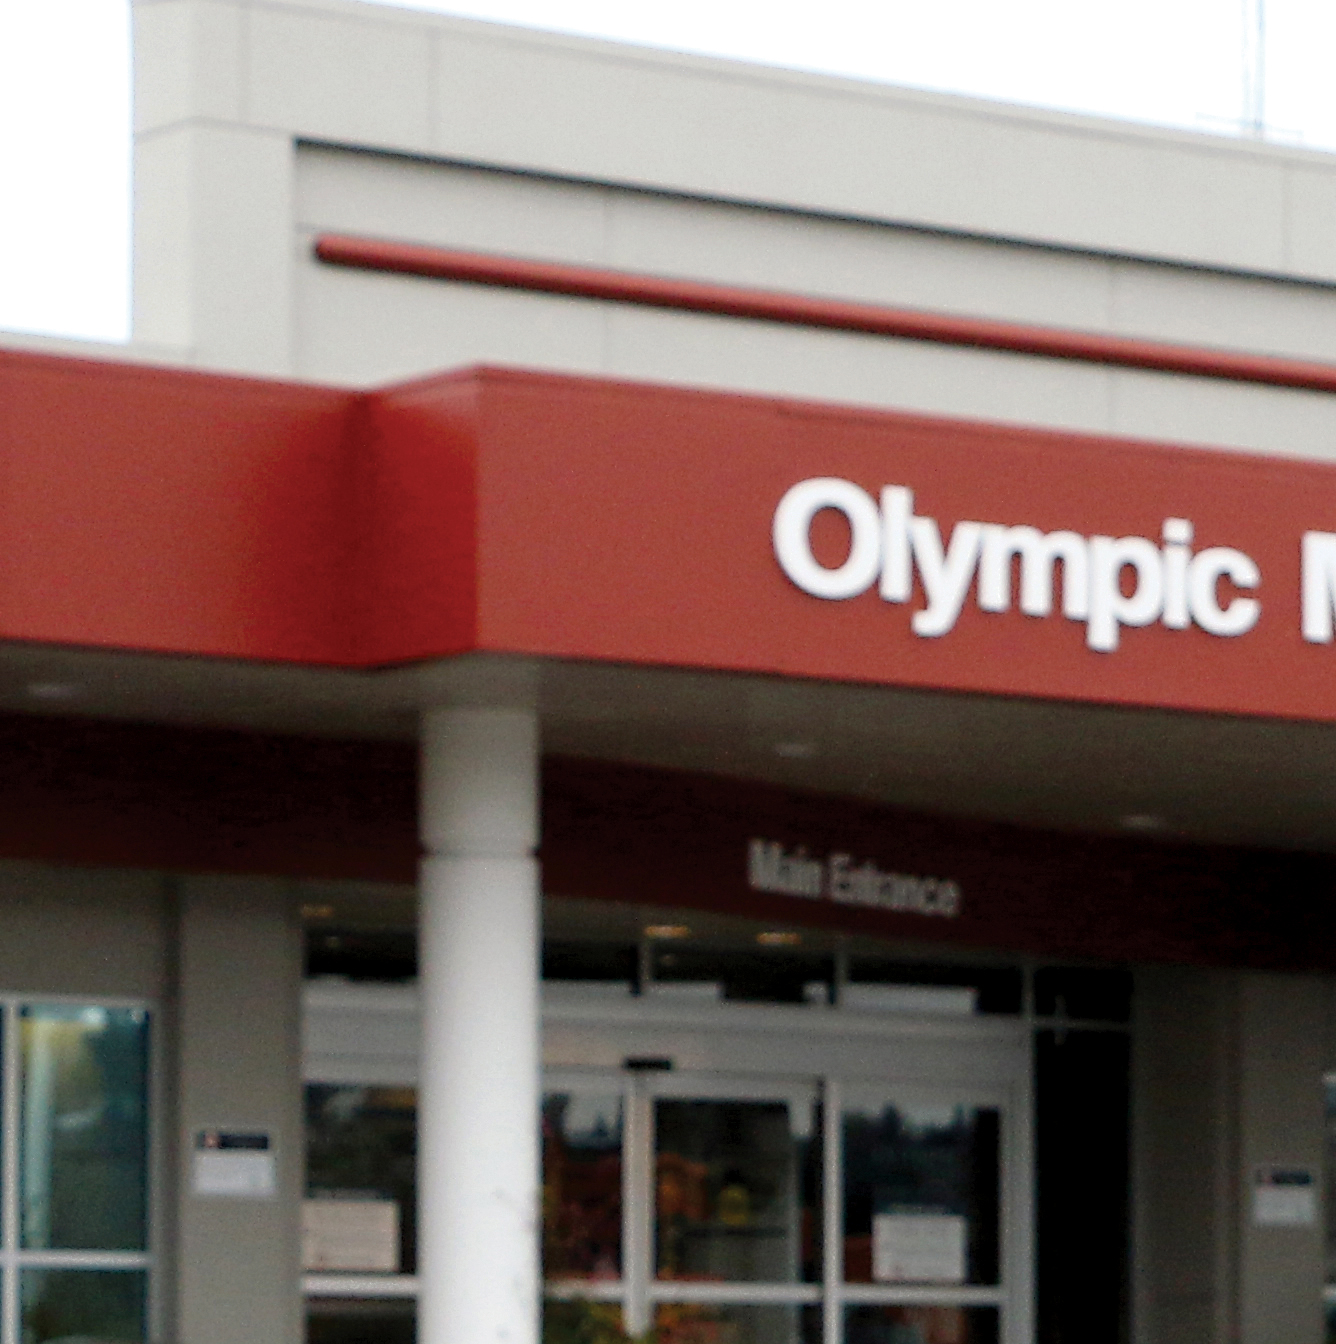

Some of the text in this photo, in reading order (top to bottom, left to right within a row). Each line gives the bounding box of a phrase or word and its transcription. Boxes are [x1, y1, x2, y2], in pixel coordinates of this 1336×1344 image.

[773, 477, 1260, 652] Olympic
[749, 839, 960, 917] Main Entrance
